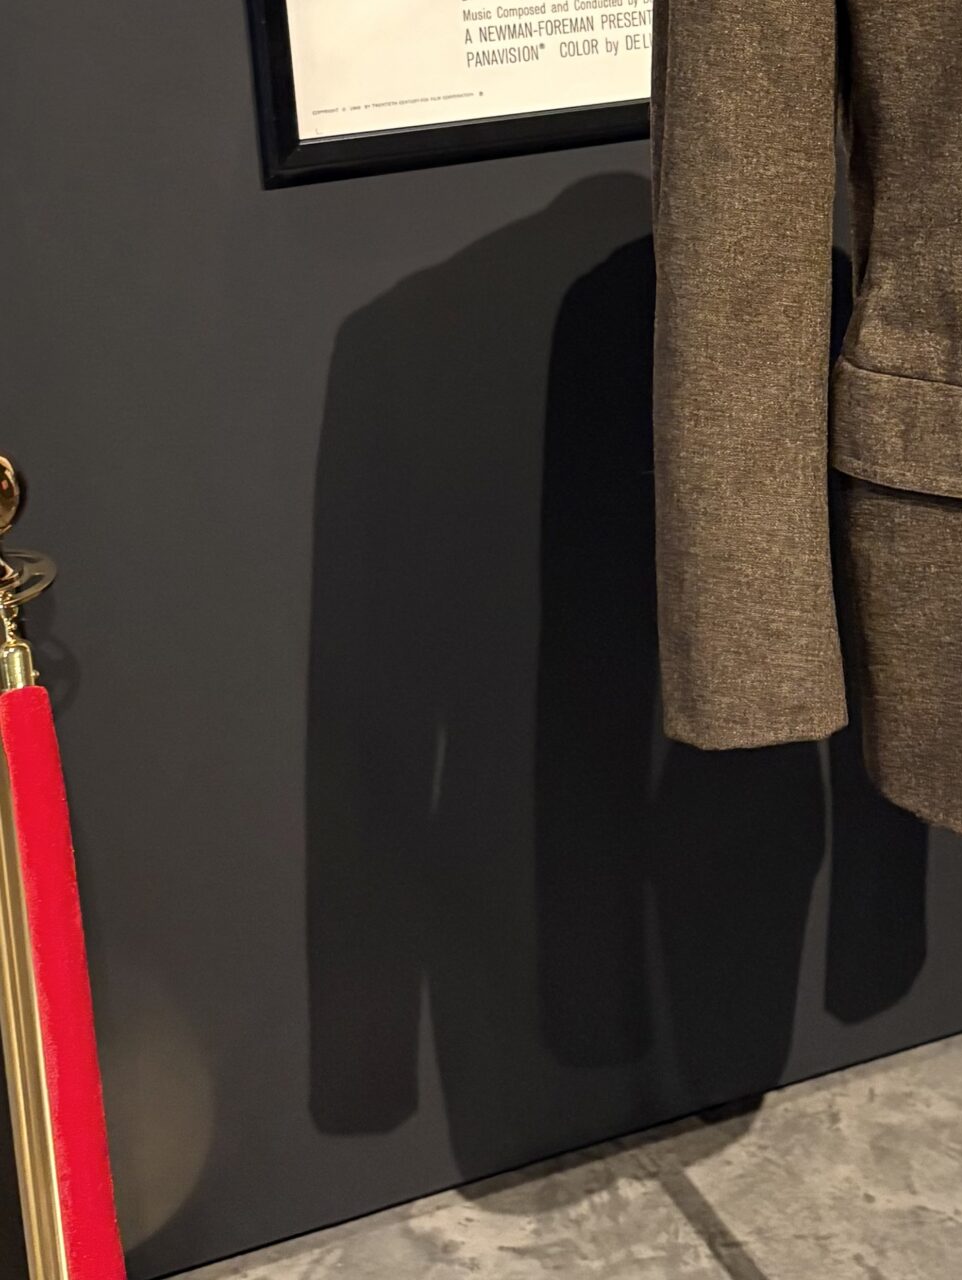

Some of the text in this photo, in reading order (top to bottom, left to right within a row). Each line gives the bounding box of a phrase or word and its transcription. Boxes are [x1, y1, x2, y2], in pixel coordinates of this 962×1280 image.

[463, 9, 491, 22] Music
[497, 2, 546, 19] Composed
[551, 0, 568, 13] and
[465, 10, 653, 44] A NEWMAN-FOREMAN PRESENT
[560, 39, 599, 58] COLOR
[605, 37, 619, 56] by
